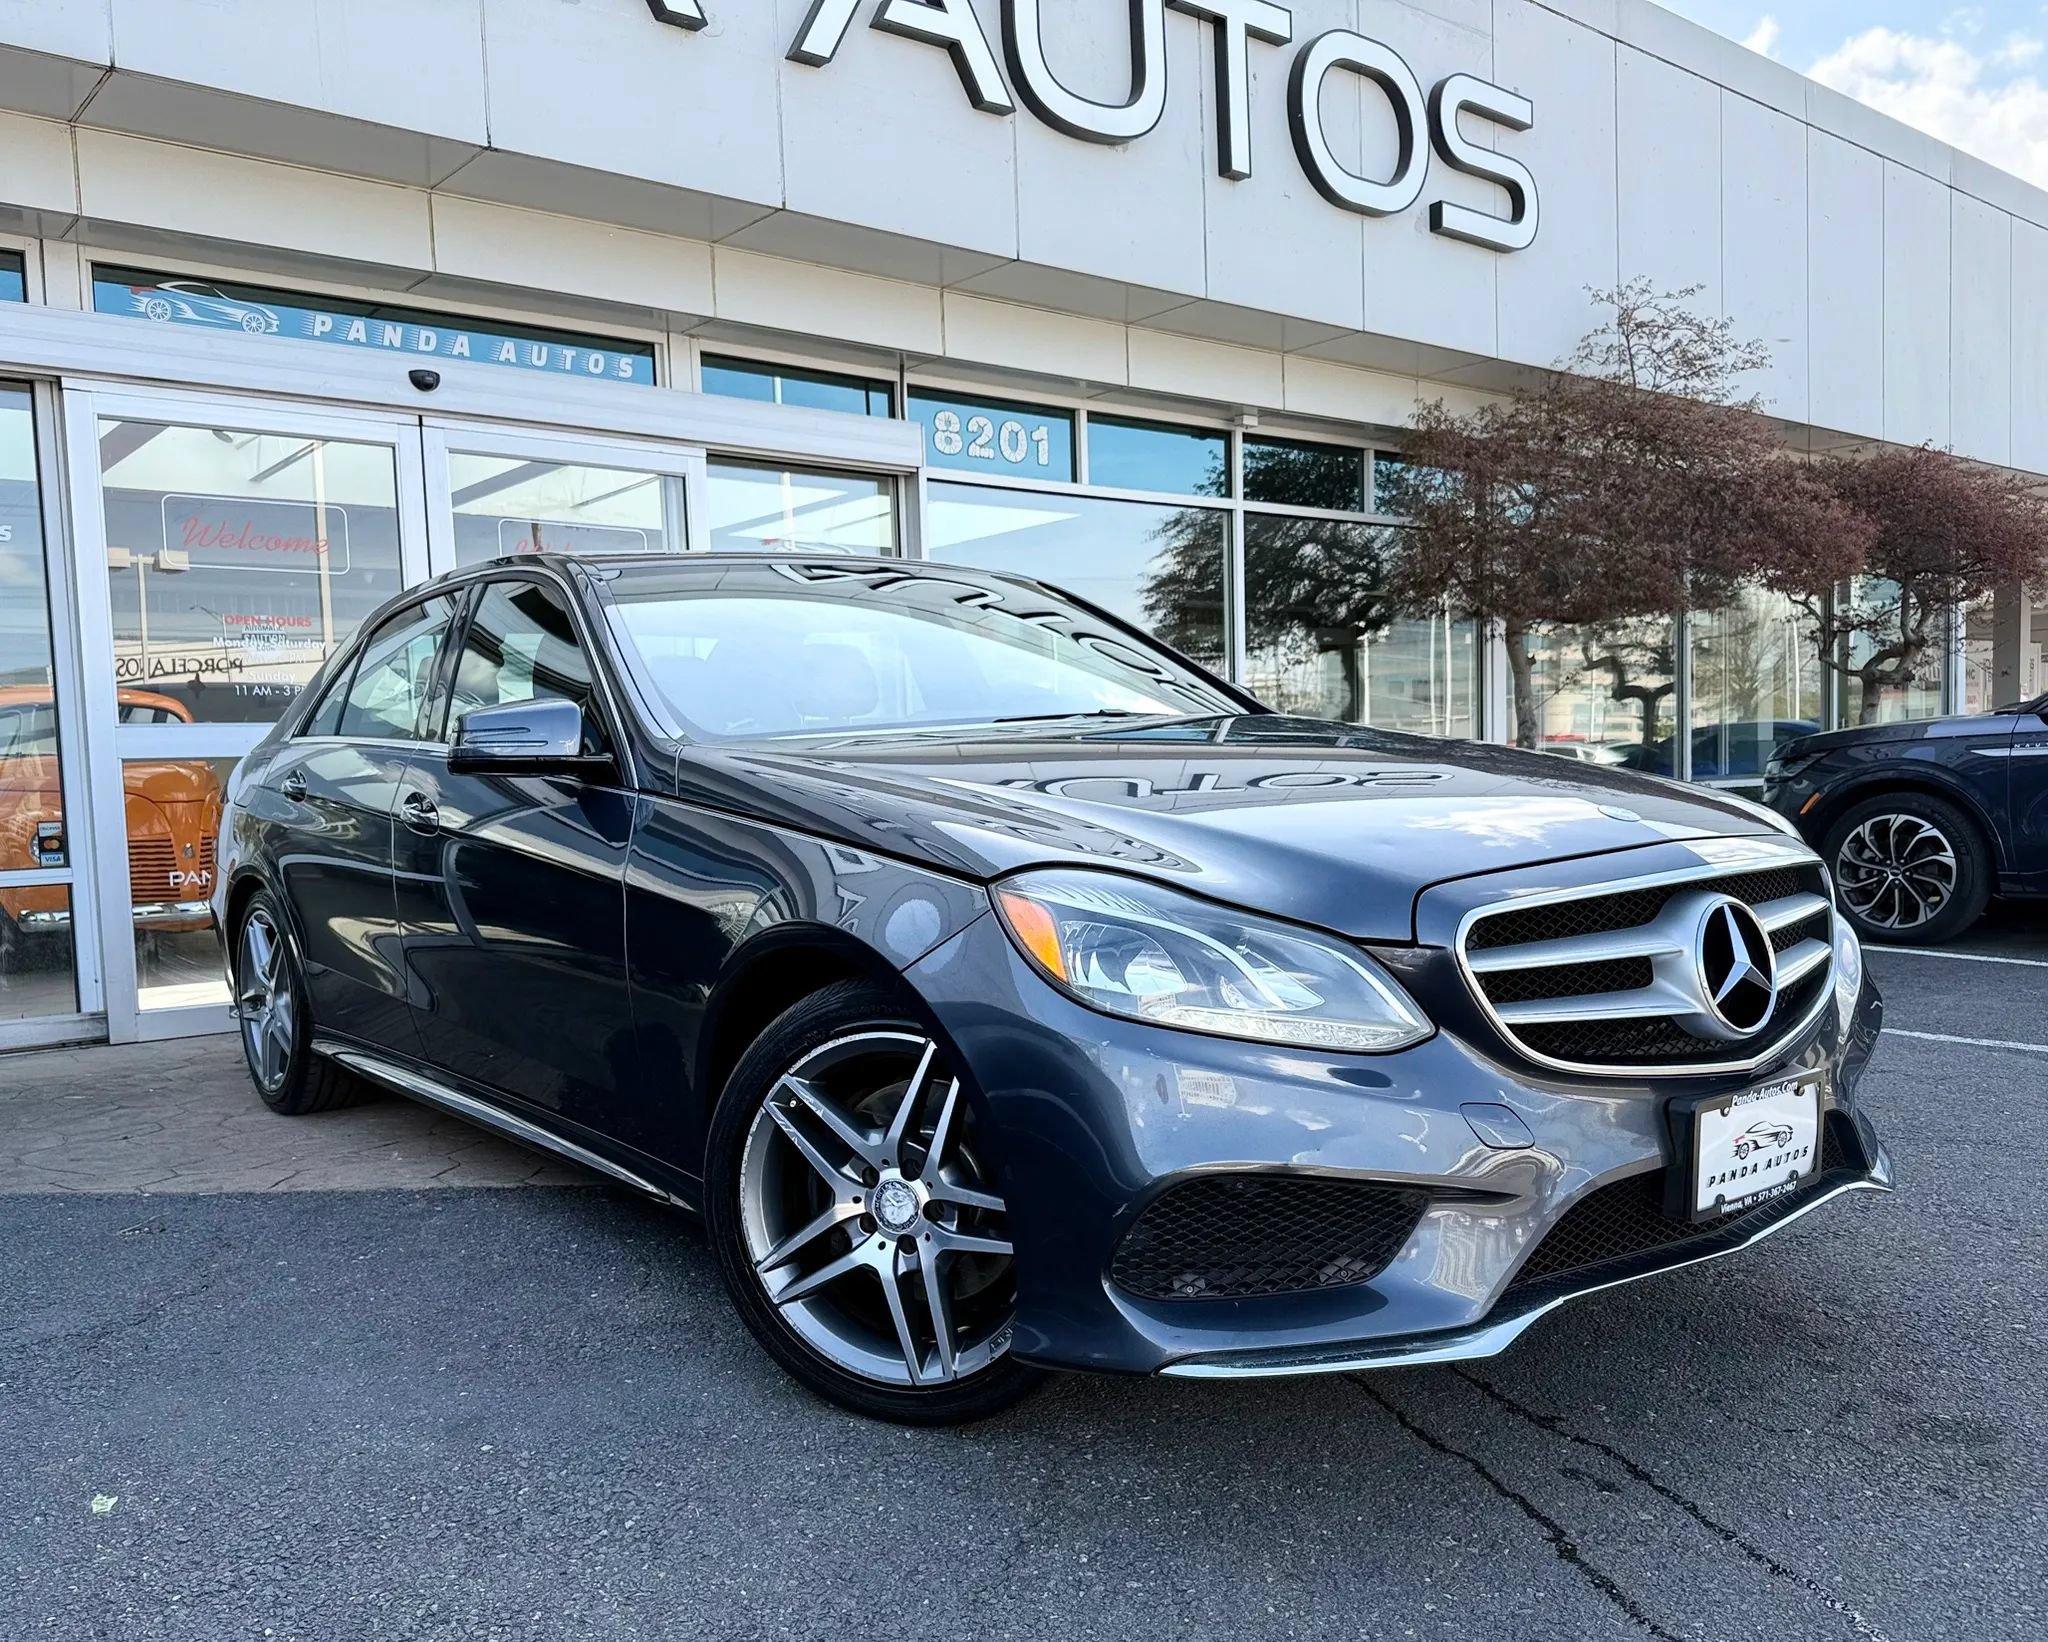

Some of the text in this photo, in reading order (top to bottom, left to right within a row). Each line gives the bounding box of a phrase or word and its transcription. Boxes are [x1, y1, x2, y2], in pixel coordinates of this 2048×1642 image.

[311, 314, 634, 379] PANDA AUTOS
[933, 411, 1048, 466] 8201
[181, 516, 329, 554] Welcome
[223, 614, 312, 628] OPEN HOURS
[248, 671, 297, 684] Sunday
[234, 684, 248, 696] 11
[252, 685, 272, 697] AM
[283, 685, 291, 696] 3
[44, 855, 62, 863] VISA
[1731, 1080, 1799, 1108] Panda-Autos.Com
[1707, 1146, 1809, 1188] PANDA AUTOS
[1744, 1195, 1753, 1206] VA
